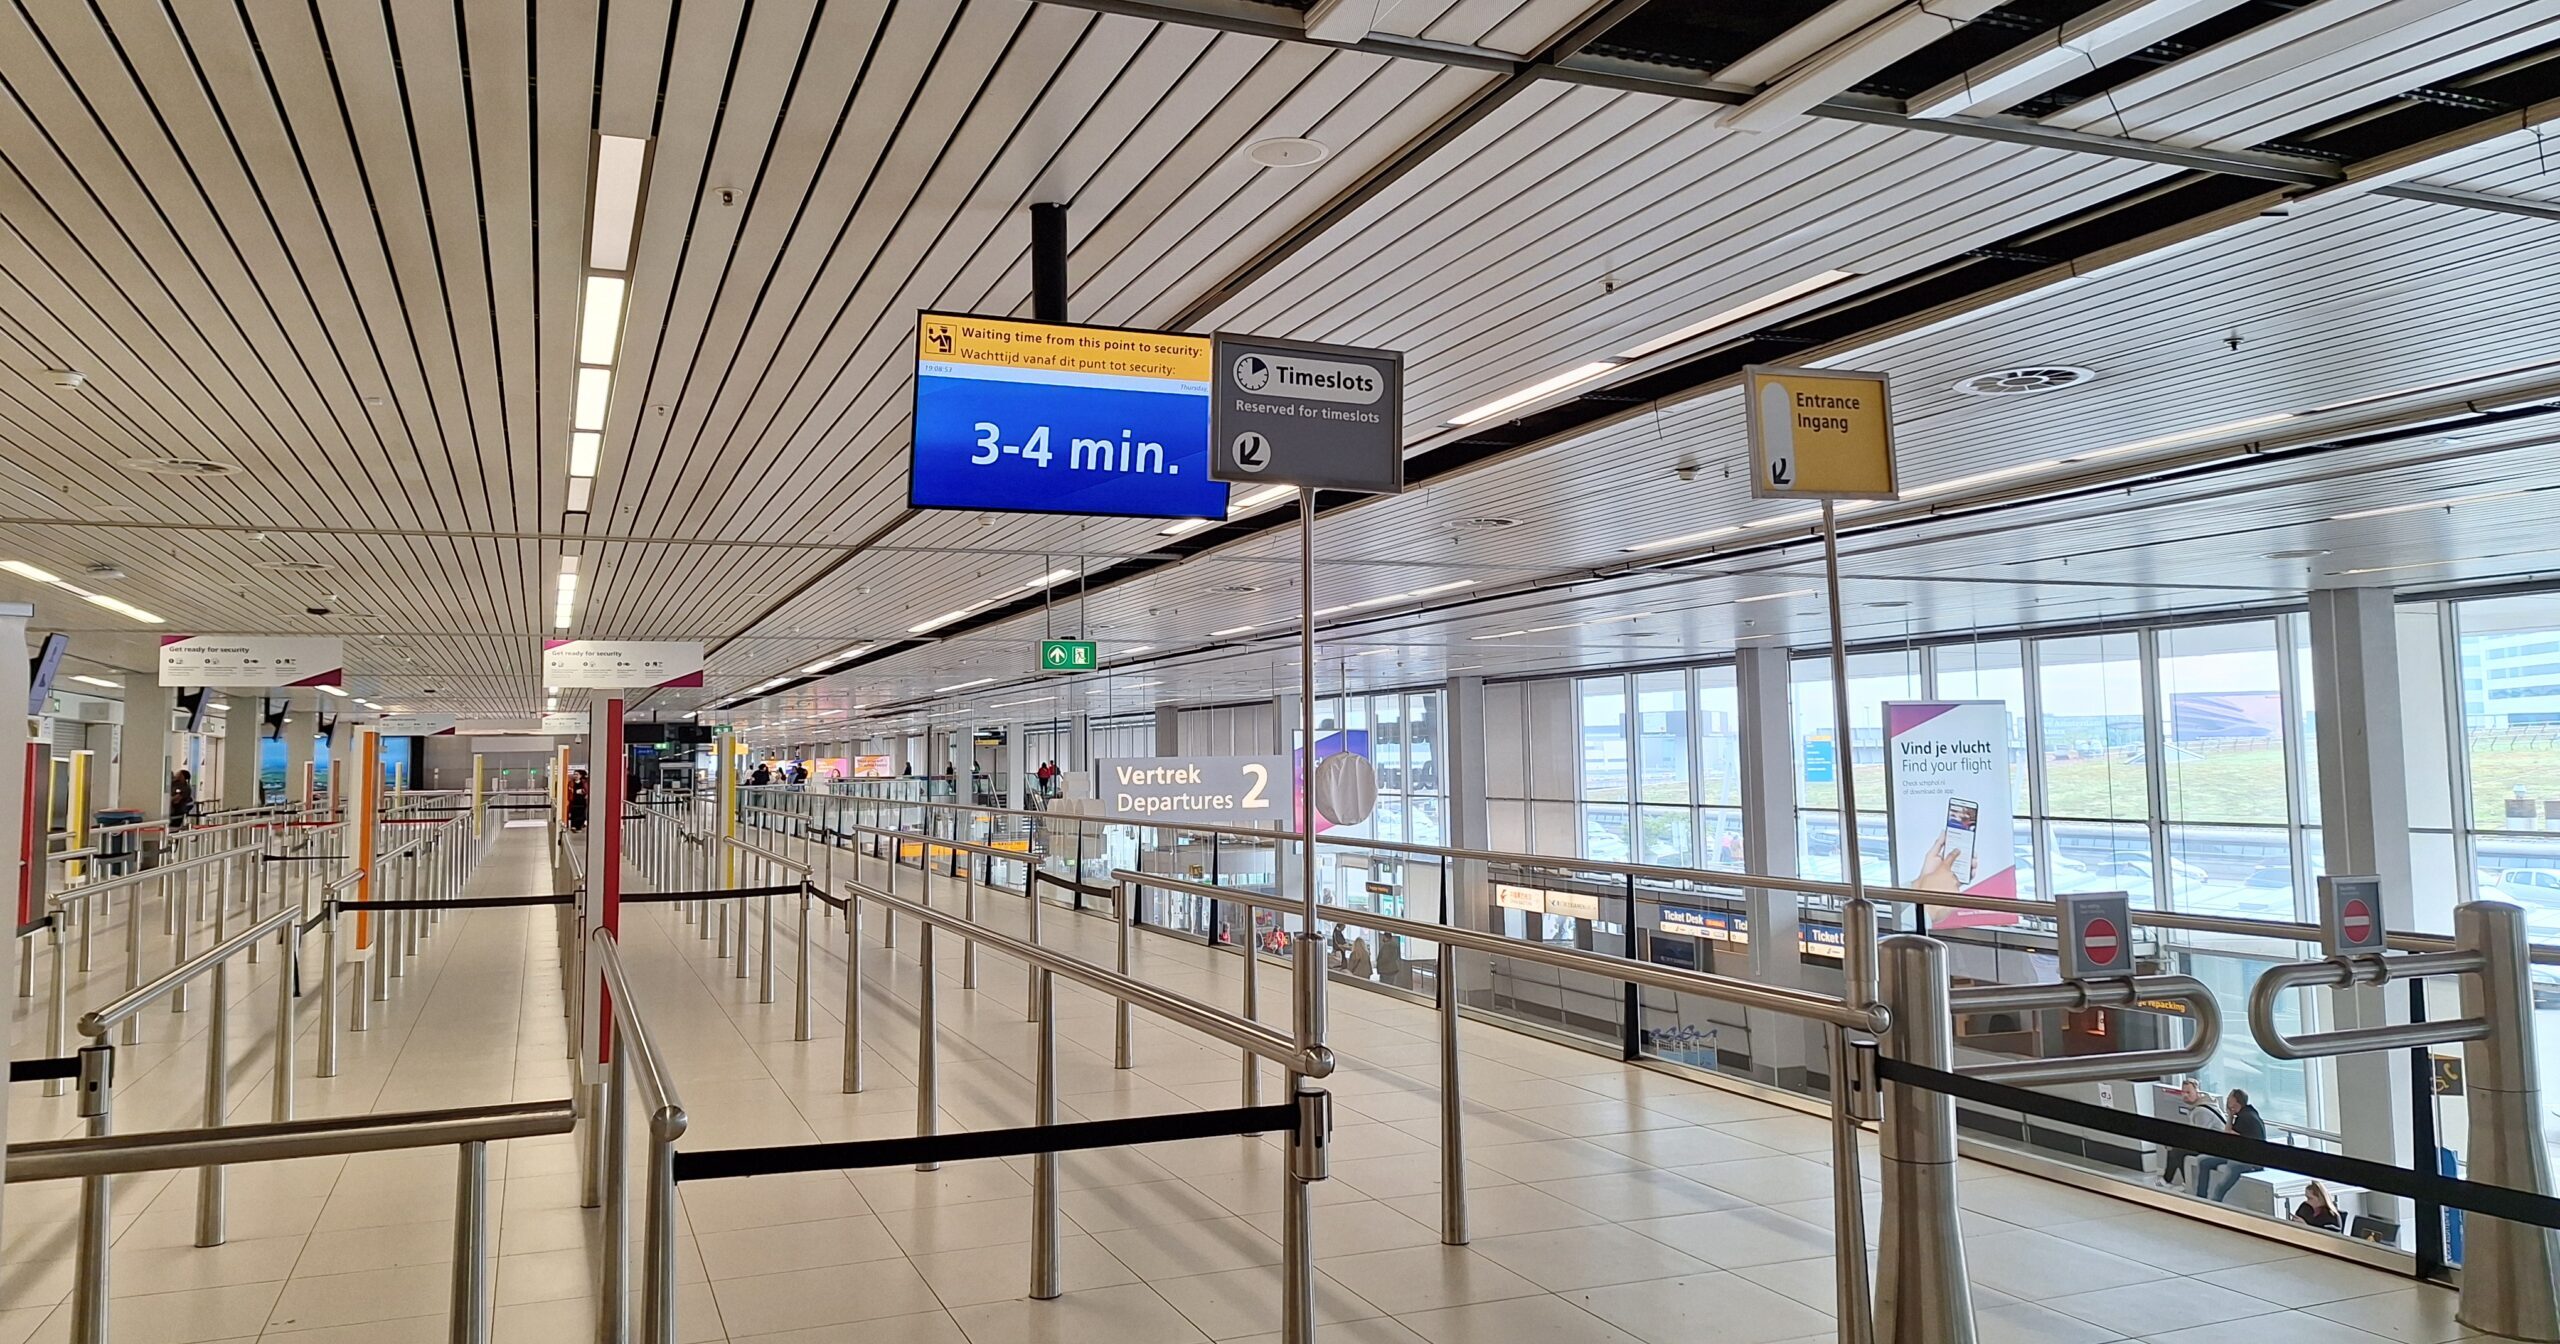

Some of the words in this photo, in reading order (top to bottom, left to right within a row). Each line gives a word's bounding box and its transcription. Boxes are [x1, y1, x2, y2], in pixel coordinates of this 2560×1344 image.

[961, 326, 1011, 344] Waiting
[1015, 331, 1042, 343] time
[1046, 333, 1075, 346] from
[1078, 337, 1101, 349] this
[1104, 339, 1136, 352] point
[1139, 342, 1151, 353] to
[1154, 345, 1203, 359] security:
[960, 348, 1020, 365] Wachttijd
[1023, 354, 1057, 366] vanaf
[1059, 356, 1076, 368] dit
[1078, 359, 1106, 371] punt
[1110, 361, 1127, 372] tot
[1129, 363, 1176, 377] security:
[1275, 365, 1374, 393] Timeslots
[1235, 399, 1295, 416] Reserved
[1299, 404, 1319, 419] for
[1321, 408, 1381, 424] timeslots
[1796, 392, 1860, 410] Entrance
[1797, 413, 1848, 433] Ingang
[971, 421, 1053, 468] 3-4
[1070, 429, 1179, 475] min.
[184, 646, 205, 655] ready
[220, 646, 250, 655] security
[565, 650, 584, 658] ready
[1900, 740, 1931, 755] Vind
[1935, 740, 1947, 758] je
[1951, 739, 1991, 754] vlucht
[1116, 763, 1201, 785] Vertrek
[1902, 758, 1928, 772] Find
[1930, 761, 1957, 775] your
[1960, 757, 1992, 774] flight
[1241, 763, 1270, 809] 2
[1117, 792, 1234, 816] Departures
[1663, 909, 1685, 923] Ticket
[1685, 912, 1704, 926] Desk
[1812, 928, 1840, 944] Ticket
